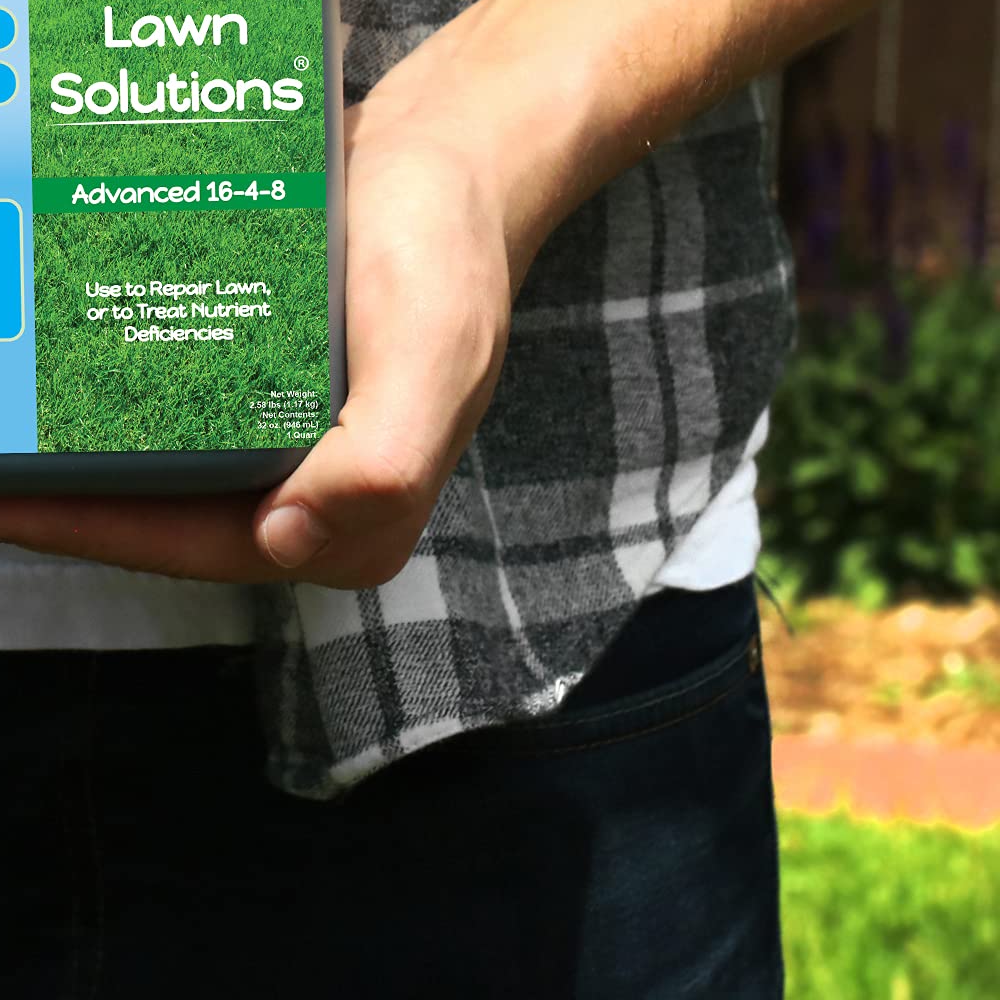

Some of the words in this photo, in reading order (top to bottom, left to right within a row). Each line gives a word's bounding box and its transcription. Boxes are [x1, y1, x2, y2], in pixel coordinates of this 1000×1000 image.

[104, 5, 248, 48] Lawn
[50, 68, 304, 115] Solutions
[71, 180, 201, 205] Advanced
[206, 180, 286, 202] 16-4-8
[85, 281, 123, 298] Use
[125, 282, 146, 297] to
[149, 280, 212, 300] Repair
[215, 280, 272, 297] Lawn,
[86, 307, 110, 321] or
[112, 304, 134, 320] to
[136, 303, 188, 320] Treat
[191, 301, 272, 318] Nutrient
[124, 325, 234, 343] Deficiencies
[270, 390, 285, 398] Net
[286, 390, 319, 399] Weight:
[249, 401, 267, 409] 2.58
[268, 400, 281, 409] lbs
[283, 401, 302, 410] (1.17
[305, 400, 319, 410] kg)
[262, 411, 277, 419] Net
[278, 411, 318, 419] Contents:
[257, 421, 267, 429] 32
[283, 421, 301, 430] (946
[302, 420, 319, 430] mL)
[293, 431, 317, 440] Quart
